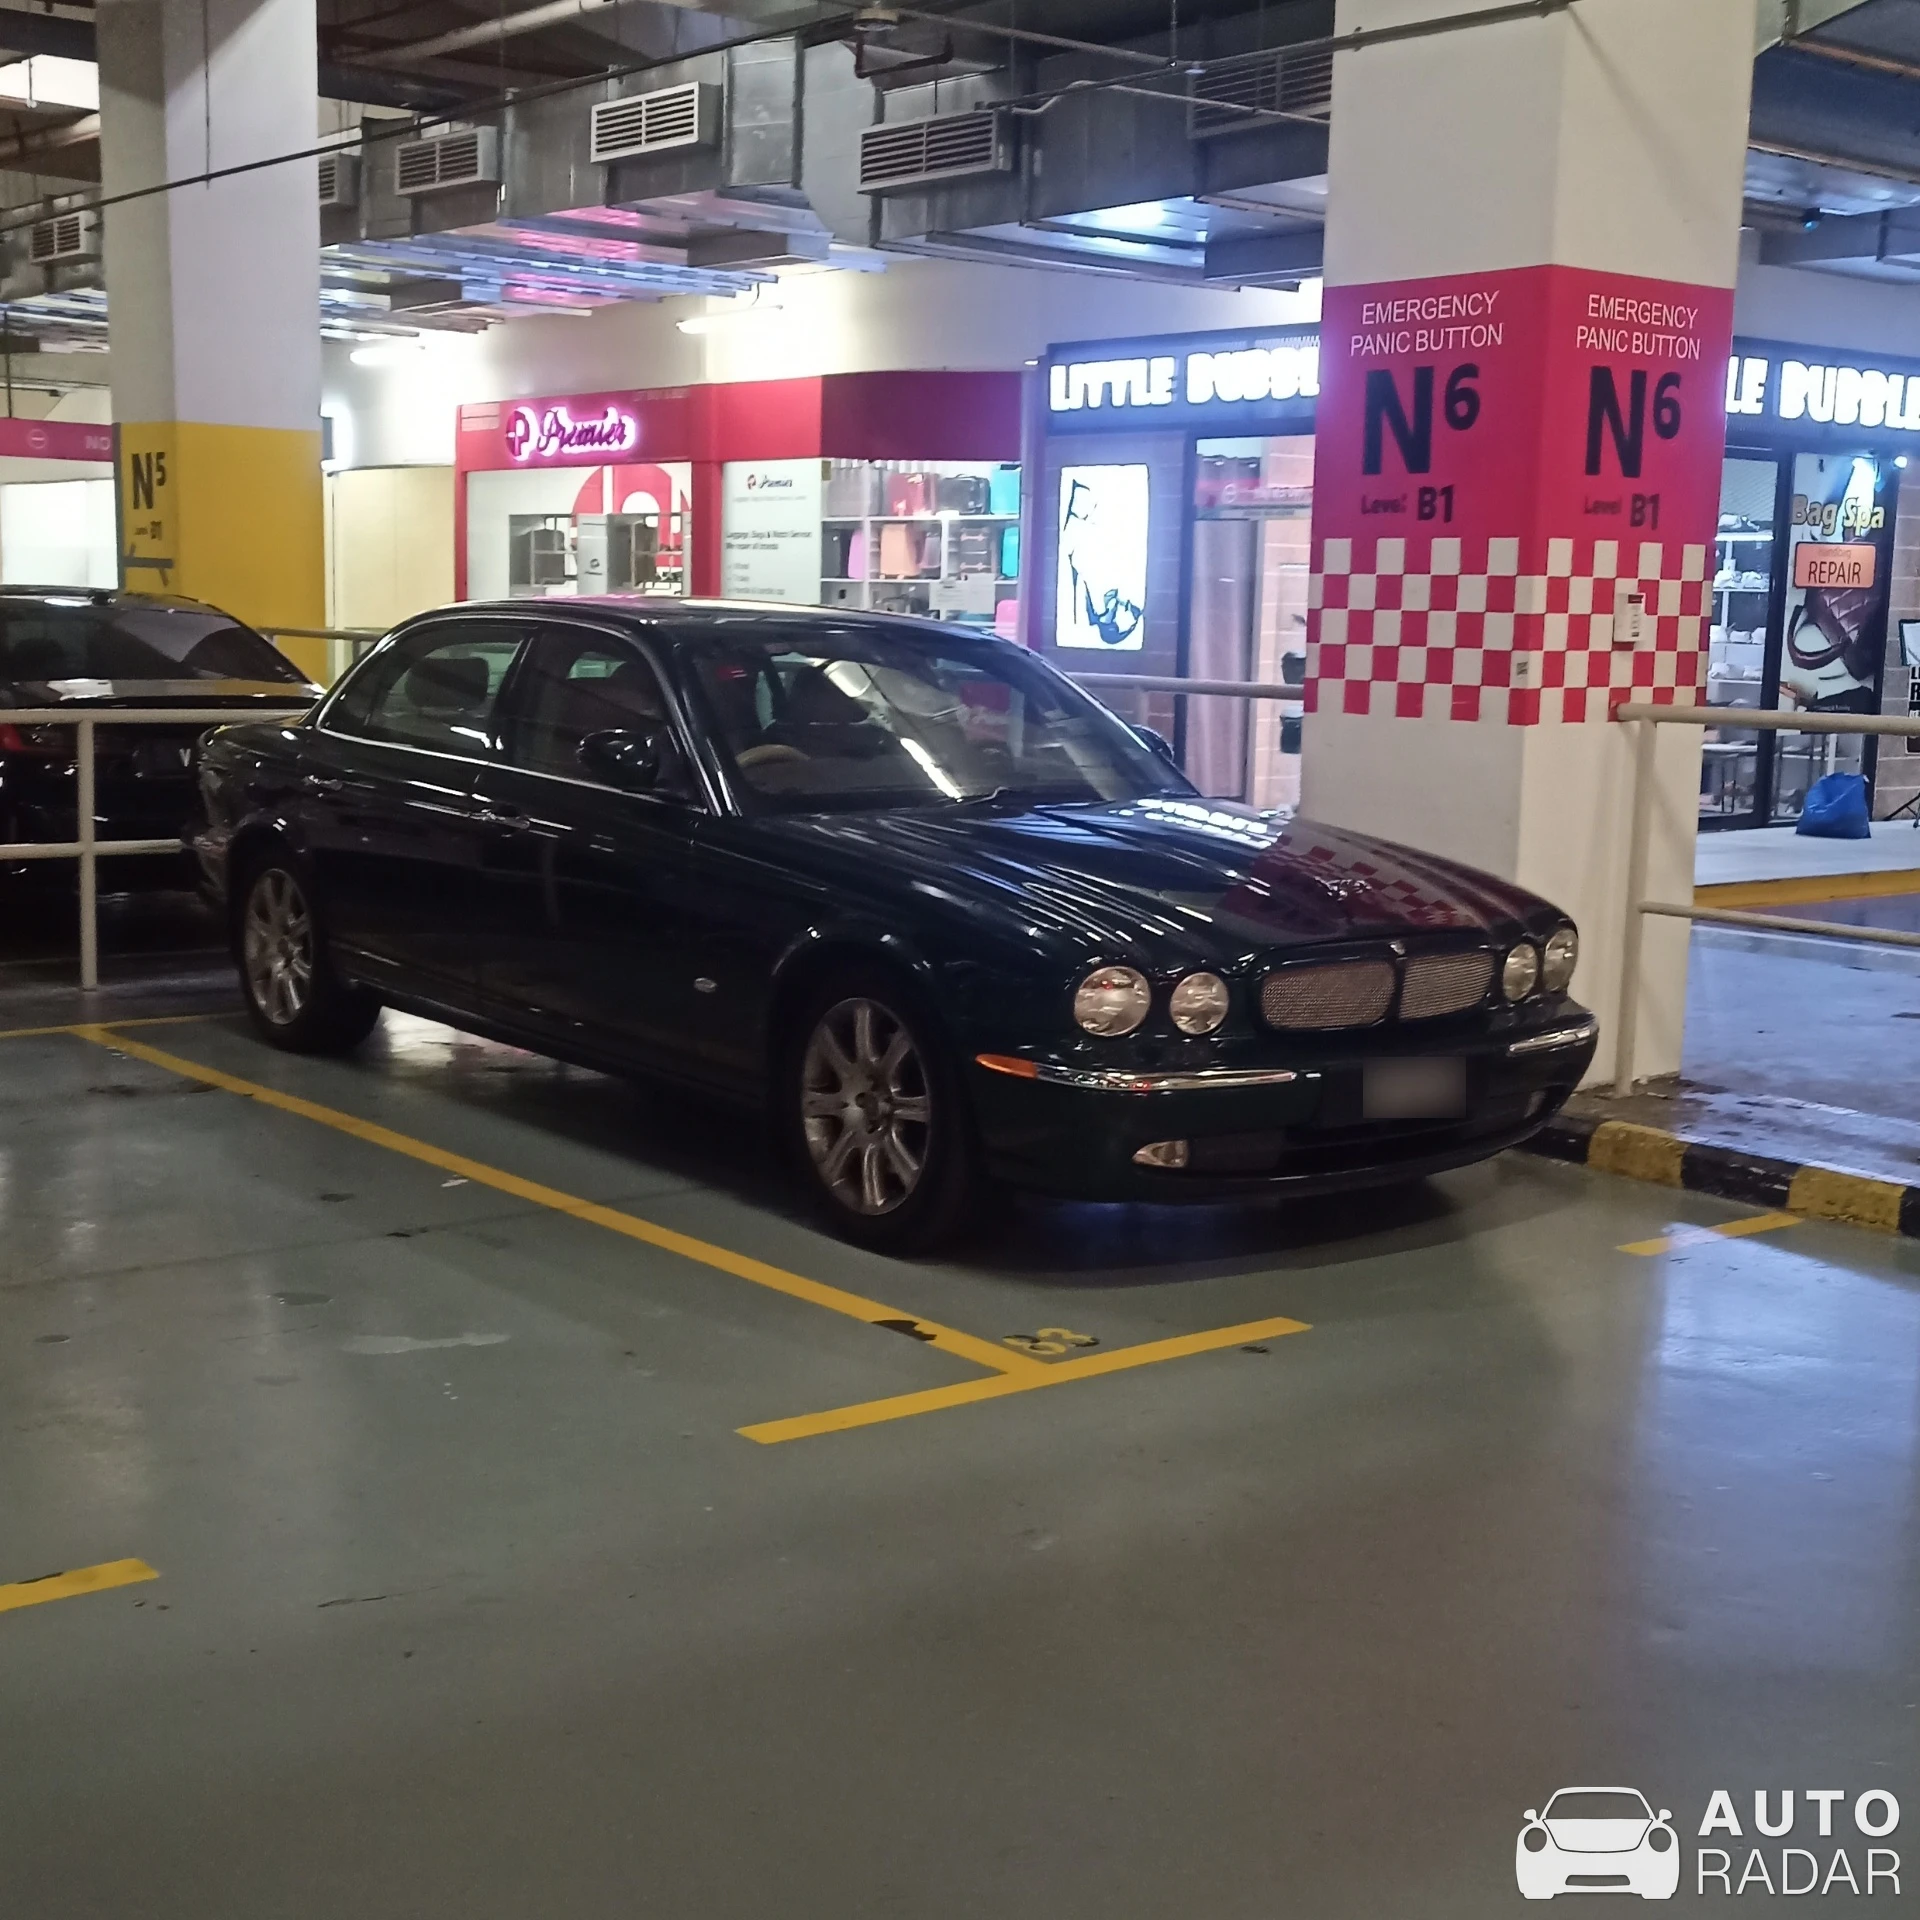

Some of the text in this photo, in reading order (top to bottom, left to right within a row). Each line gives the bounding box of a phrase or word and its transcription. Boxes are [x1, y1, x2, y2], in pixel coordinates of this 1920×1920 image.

[1361, 290, 1500, 325] EMERGENCY
[1587, 294, 1699, 329] EMERGENCY
[1350, 323, 1504, 357] PANIC BUTTON
[1576, 325, 1701, 360] PANIC BUTTON
[1050, 356, 1175, 411] LITTLE
[1417, 484, 1454, 523] B1
[1629, 492, 1661, 530] B1
[1791, 493, 1885, 537] Bag Spa
[1807, 560, 1862, 585] REPAIR
